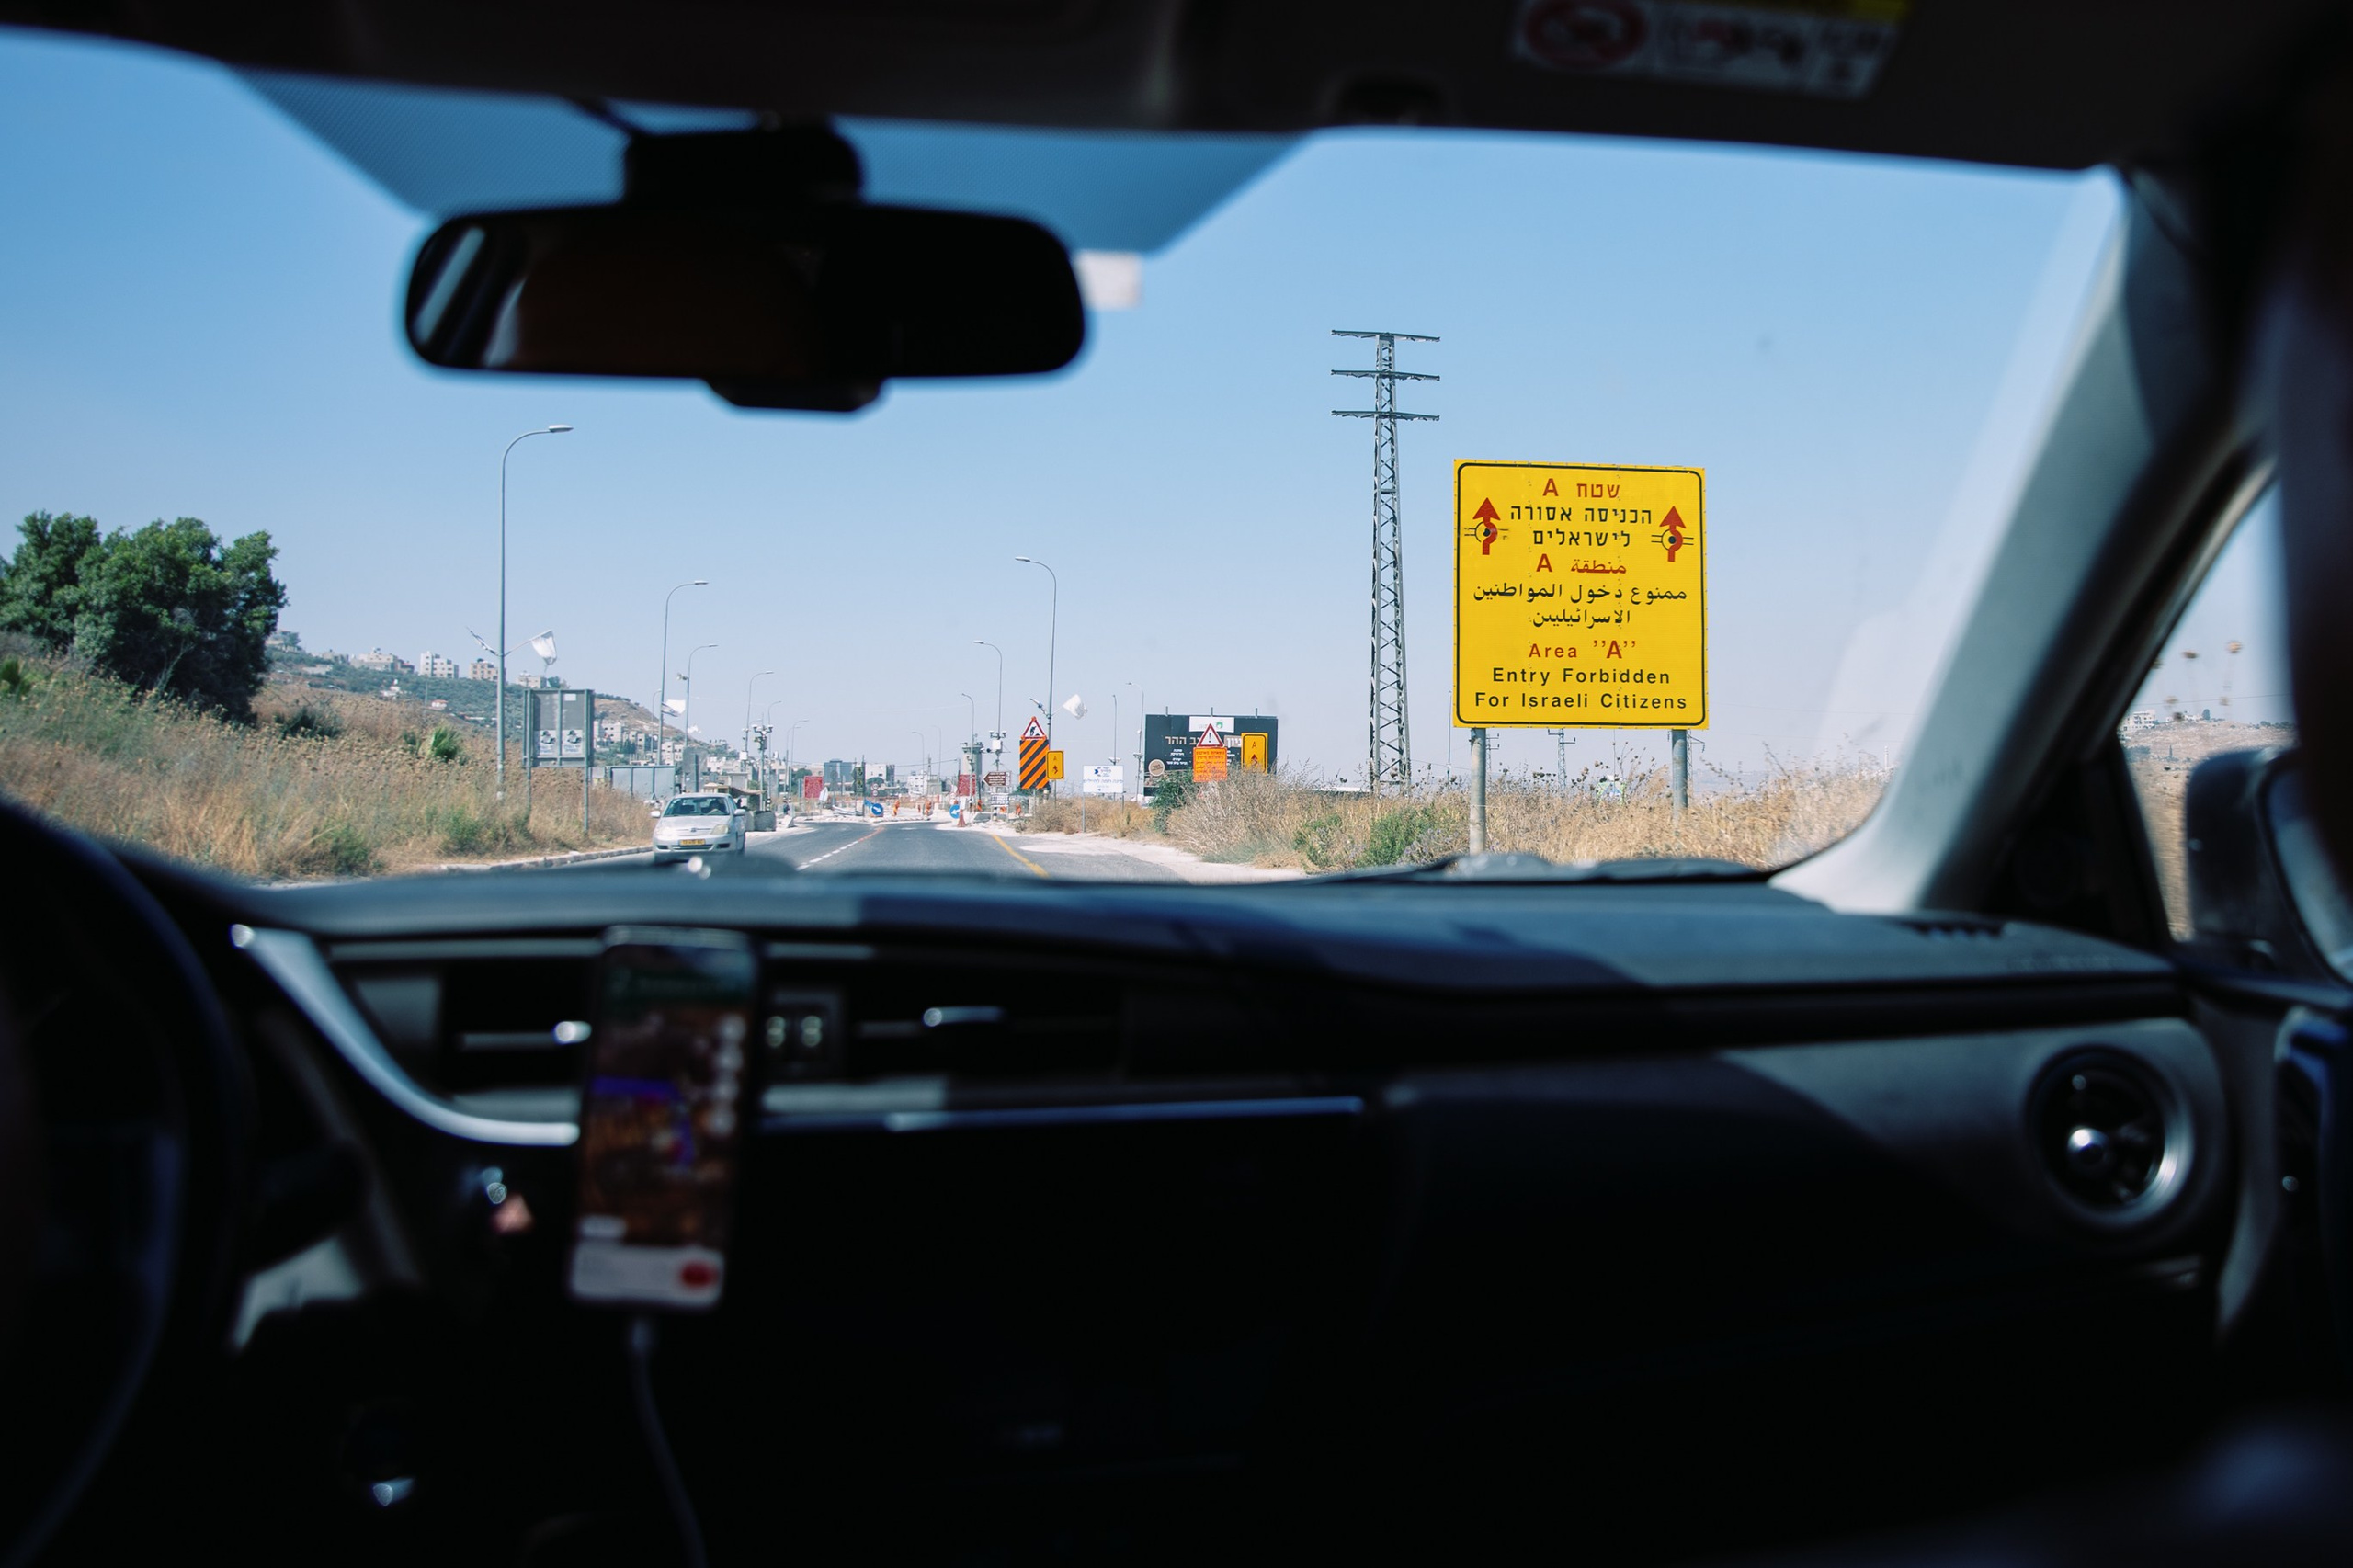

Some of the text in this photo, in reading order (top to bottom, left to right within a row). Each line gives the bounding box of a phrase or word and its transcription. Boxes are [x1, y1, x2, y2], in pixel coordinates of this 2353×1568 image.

[1542, 478, 1620, 499] שטח A
[1510, 506, 1652, 525] הכניסה אסורה
[1533, 528, 1631, 547] לישראלים
[1536, 553, 1627, 574] منطقة A
[1473, 582, 1688, 605] ممنوع دخول المواطنين
[1529, 643, 1578, 658] Area
[1493, 667, 1670, 686] Entry Forbidden
[1475, 692, 1688, 709] For Israeli Citizens
[1251, 741, 1257, 749] A
